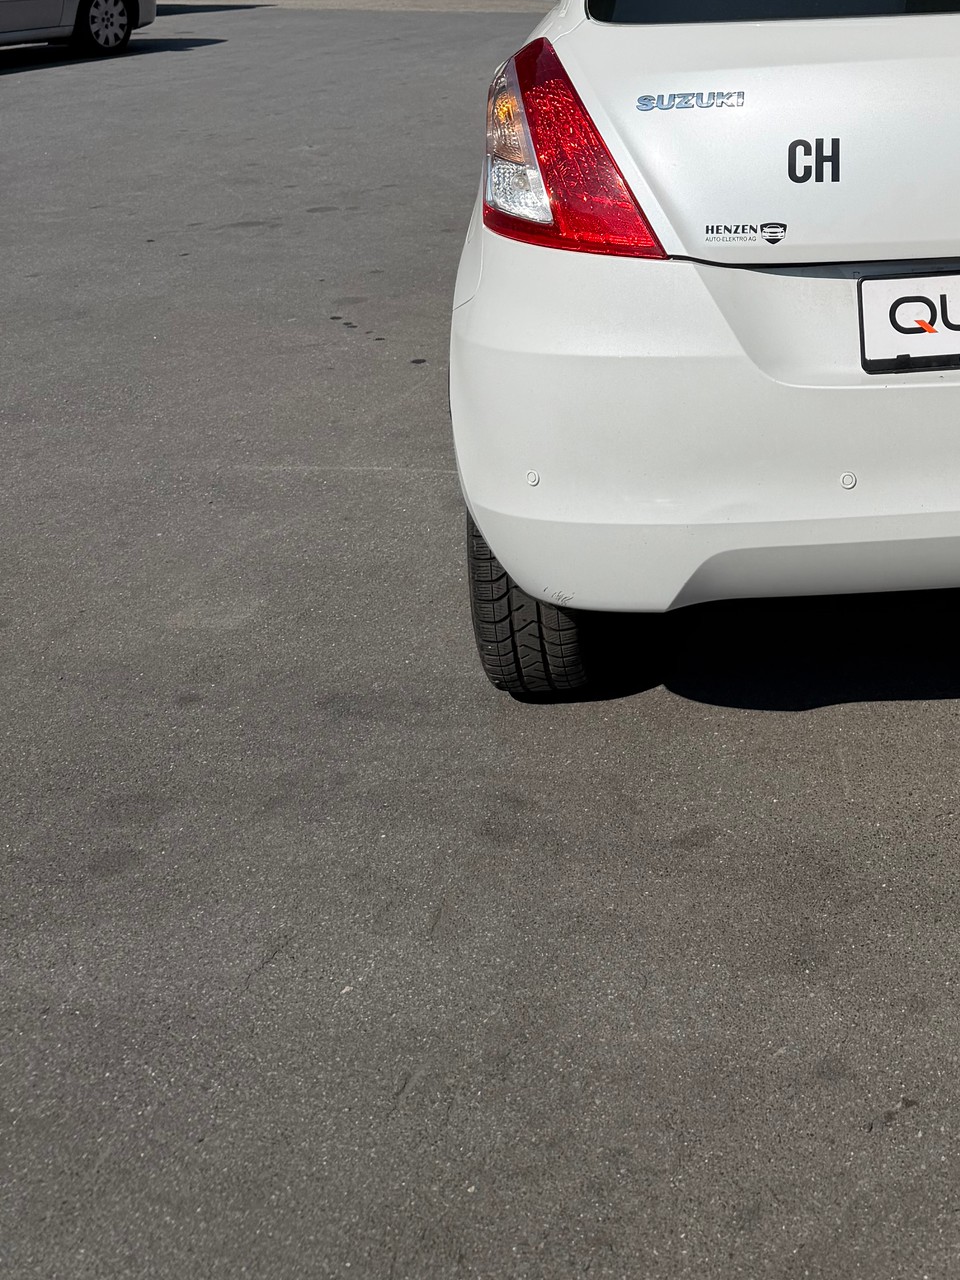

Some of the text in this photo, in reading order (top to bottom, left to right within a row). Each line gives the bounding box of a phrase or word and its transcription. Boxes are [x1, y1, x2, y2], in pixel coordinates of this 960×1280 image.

[635, 90, 745, 112] SUZUKI
[787, 137, 840, 184] CH
[705, 224, 758, 235] HENZEN
